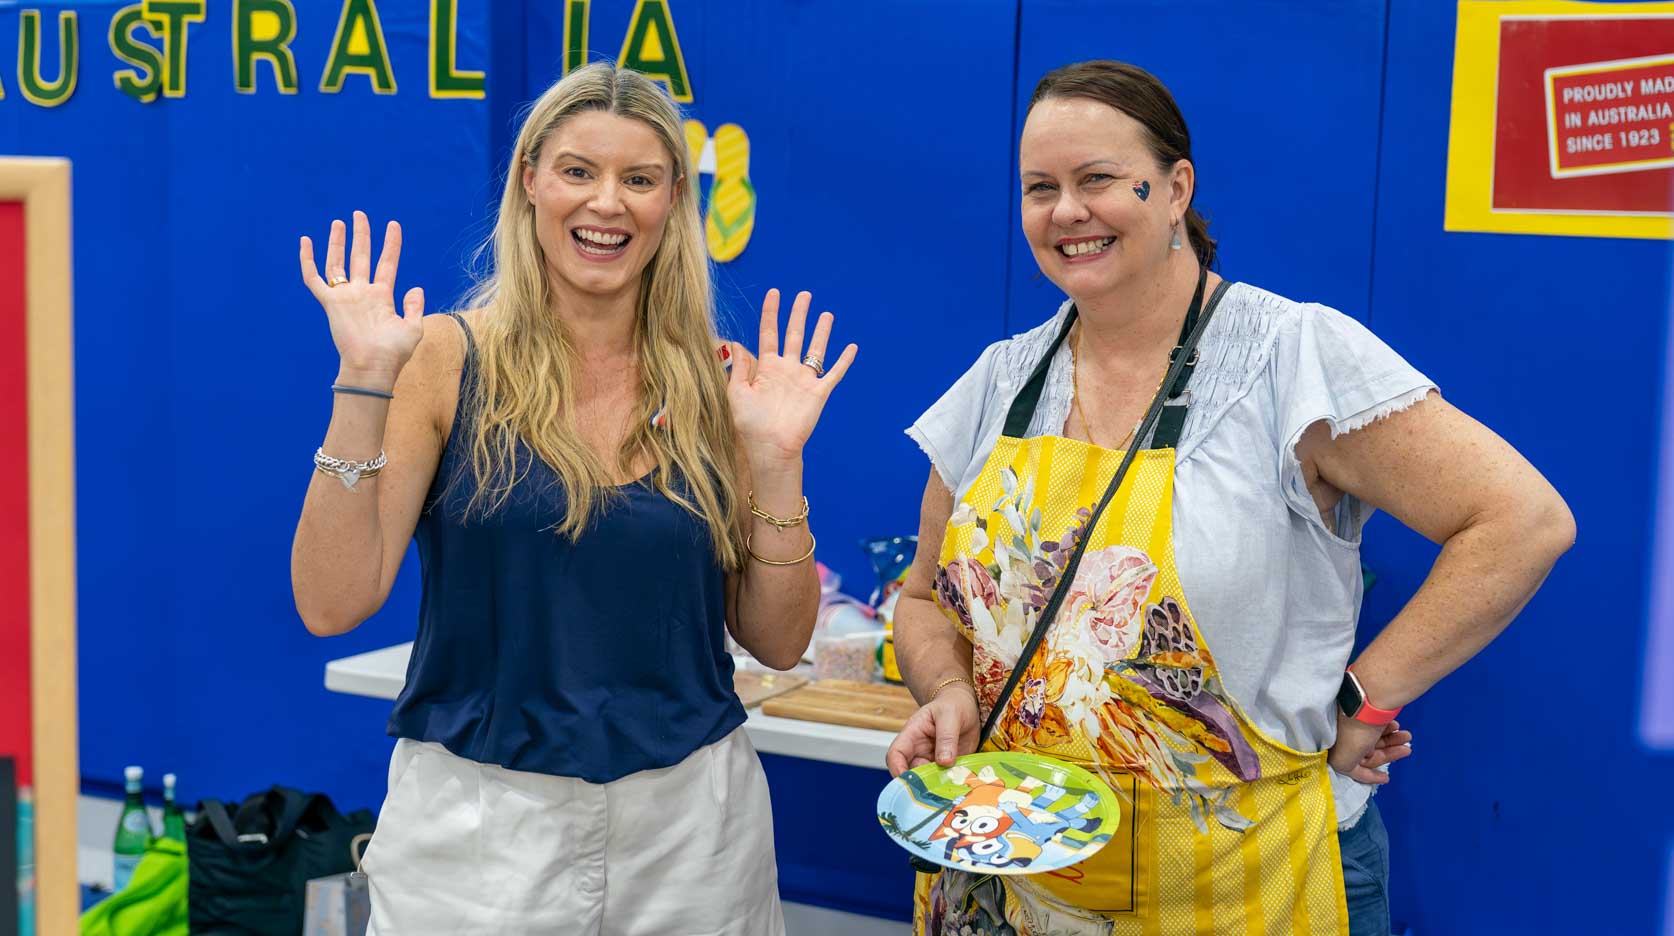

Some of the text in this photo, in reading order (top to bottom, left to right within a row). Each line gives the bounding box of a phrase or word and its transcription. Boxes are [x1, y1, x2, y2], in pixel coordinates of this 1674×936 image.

[0, 0, 694, 107] USTRALIA
[1562, 80, 1634, 104] PROUDLY
[1564, 101, 1673, 129] IN AUSTRALIA
[1566, 127, 1660, 154] SINCE 1923
